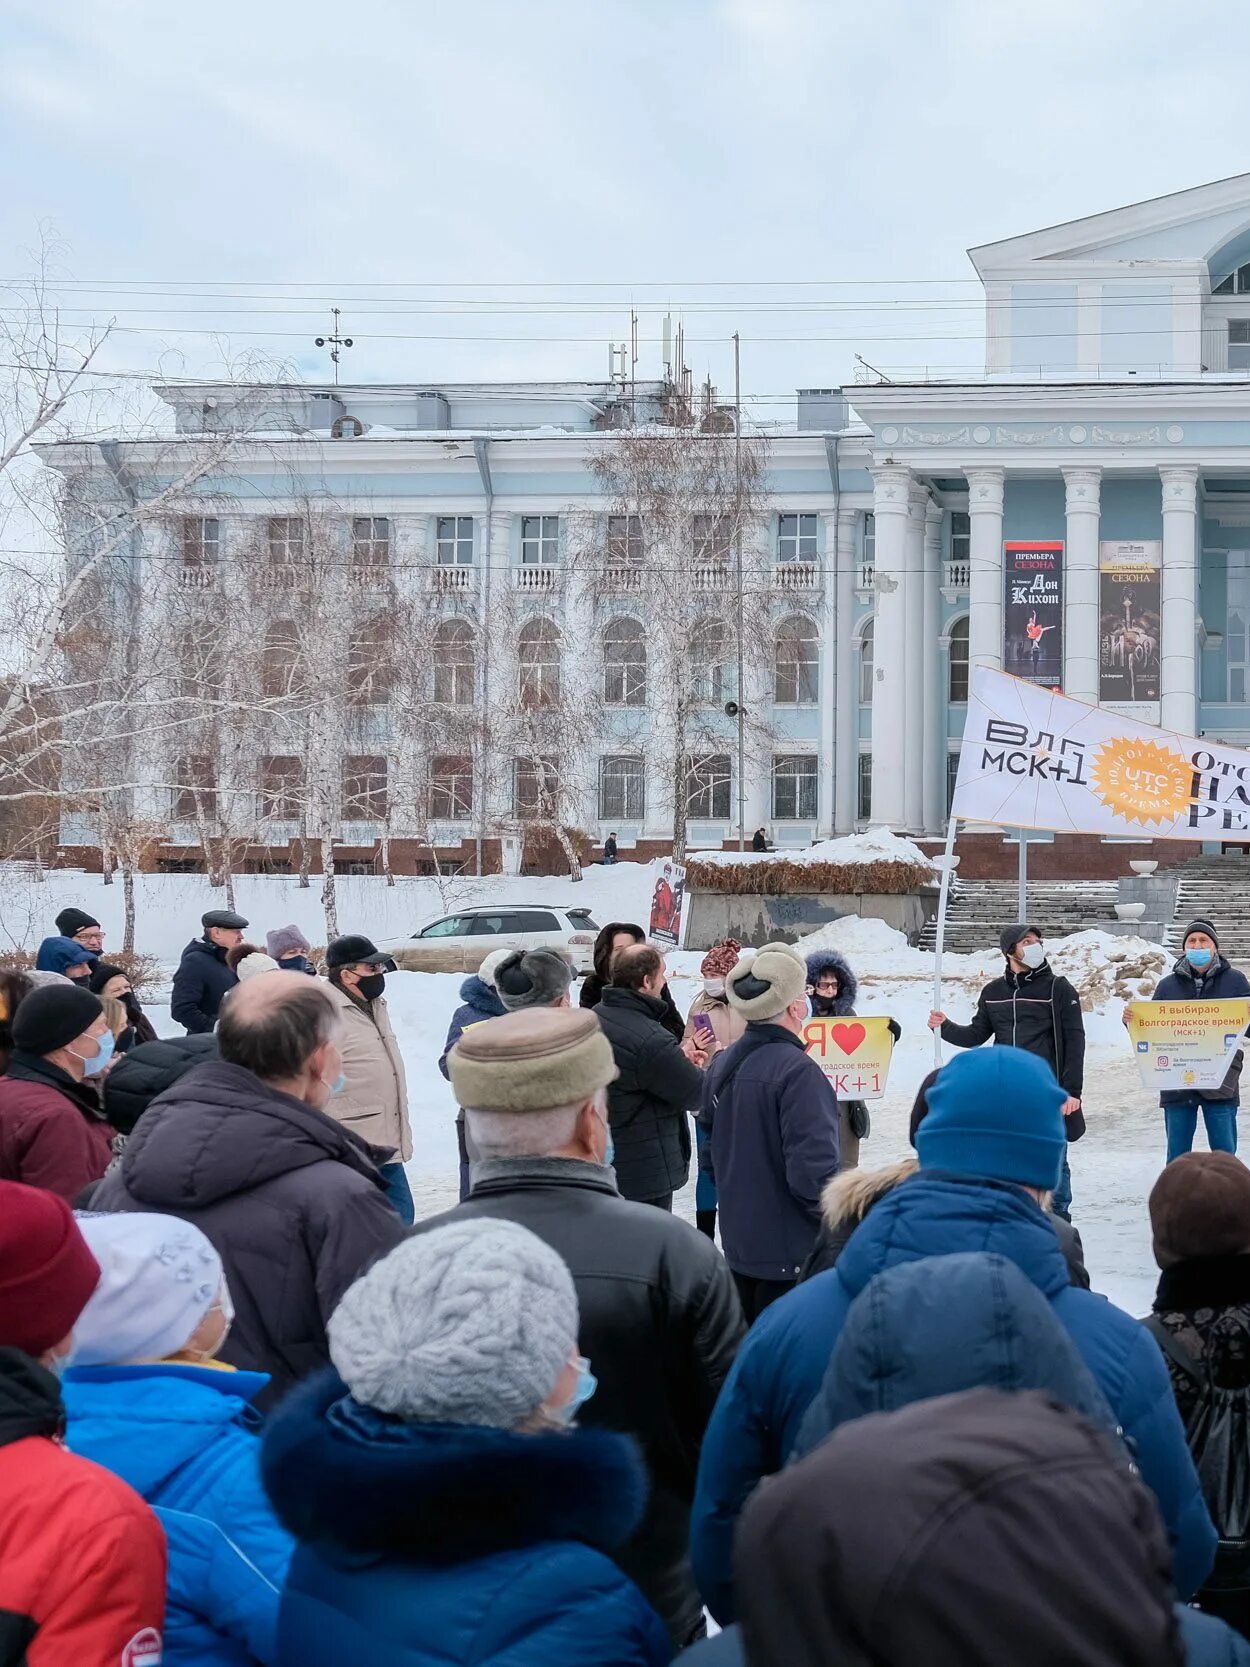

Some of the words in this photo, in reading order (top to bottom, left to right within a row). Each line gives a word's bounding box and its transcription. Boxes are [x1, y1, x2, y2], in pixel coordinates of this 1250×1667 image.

[1014, 561, 1055, 569] СЕЗОНА
[1030, 574, 1058, 593] Дон
[1111, 574, 1150, 583] СЕЗОНА
[986, 718, 1085, 755] ВЛГ
[981, 747, 1087, 785] МСК+1
[1125, 766, 1169, 787] UTC
[1159, 1006, 1166, 1014] Я
[1169, 1005, 1220, 1016] выбираю
[1139, 1018, 1209, 1028] Волгоградское
[1212, 1017, 1245, 1028] время!
[803, 1022, 826, 1057] Я
[1173, 1029, 1206, 1037] (МСК+1)
[820, 1062, 855, 1070] градское
[857, 1061, 880, 1069] время
[824, 1073, 881, 1093] К+1
